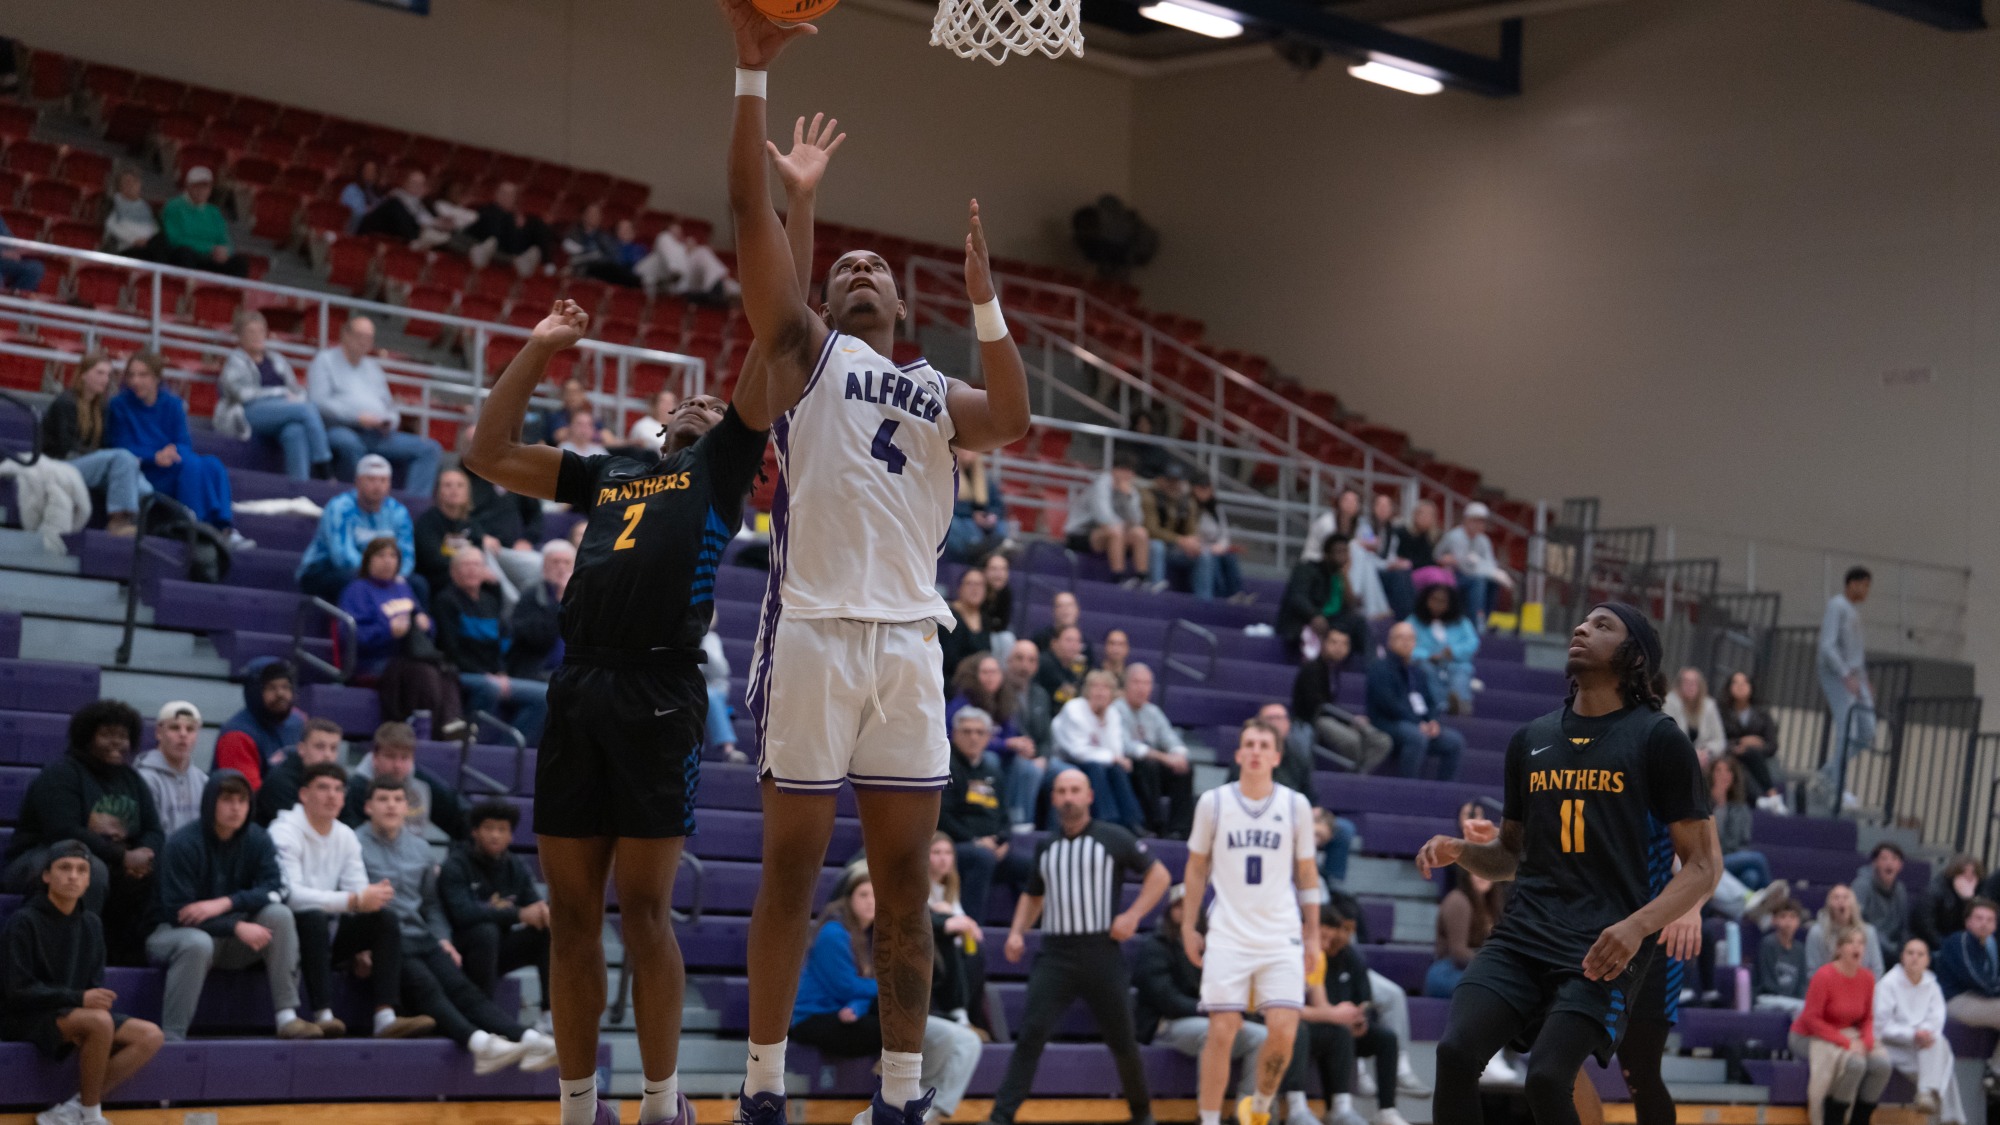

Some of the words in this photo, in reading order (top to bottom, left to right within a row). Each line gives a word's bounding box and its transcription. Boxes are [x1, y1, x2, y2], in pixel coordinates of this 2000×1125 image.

[844, 370, 943, 423] ALFRED
[871, 418, 907, 475] 4
[596, 471, 691, 507] PANTHERS
[613, 502, 647, 551] 2
[1529, 768, 1625, 793] PANTHERS
[1227, 829, 1282, 850] ALFRED
[1560, 799, 1585, 853] 11
[1245, 855, 1263, 885] 0
